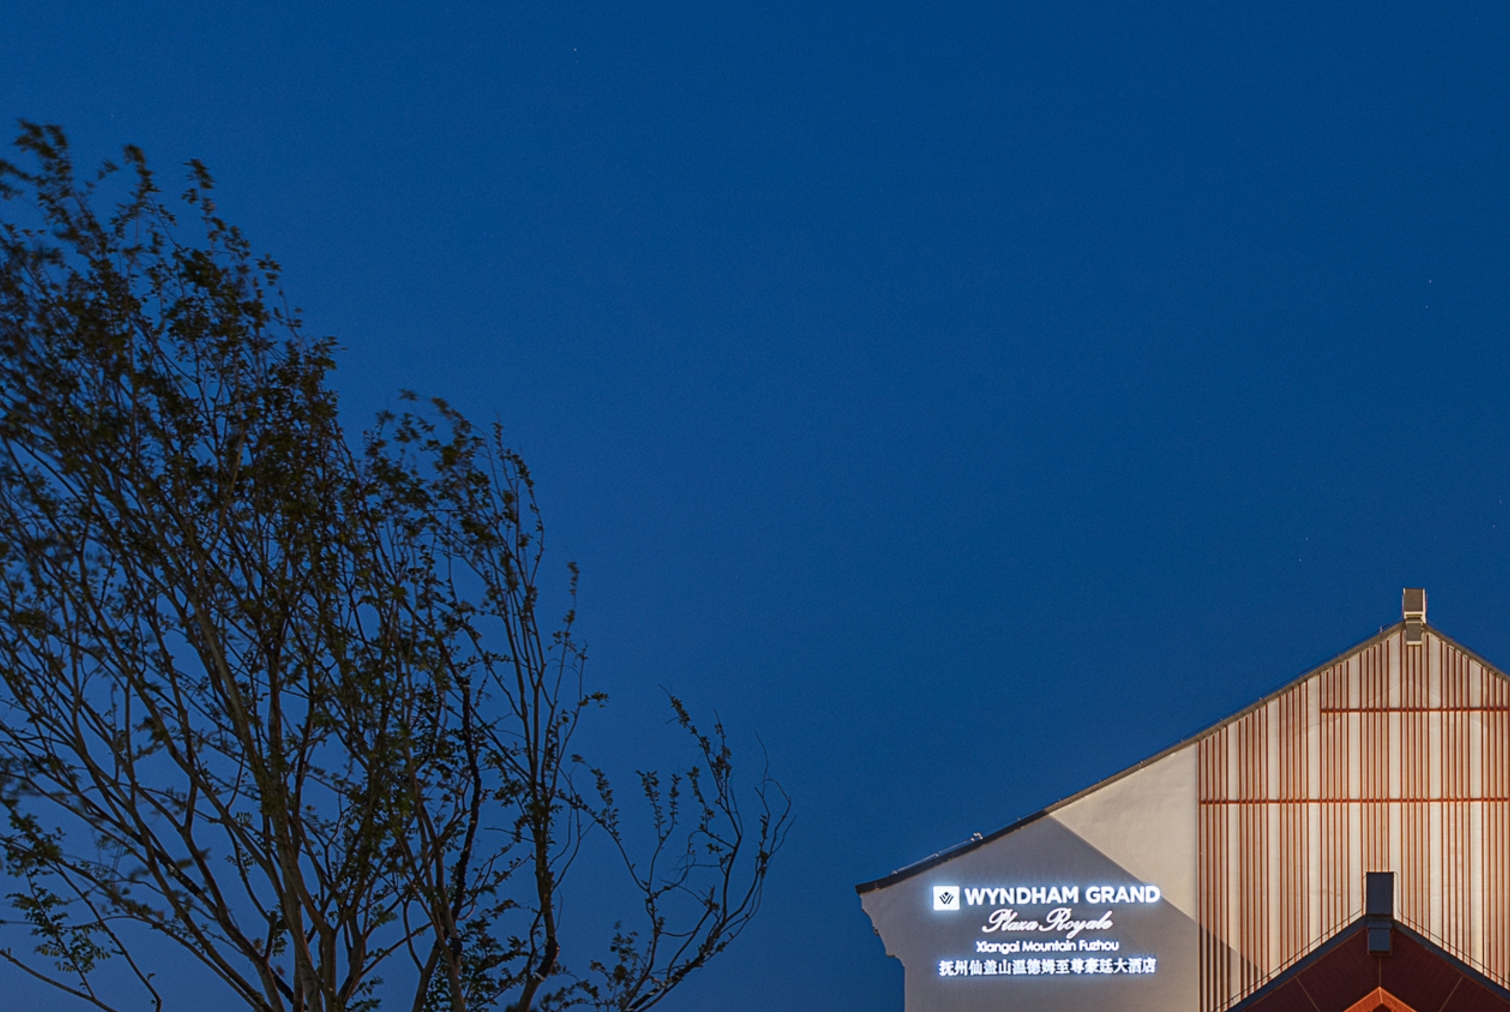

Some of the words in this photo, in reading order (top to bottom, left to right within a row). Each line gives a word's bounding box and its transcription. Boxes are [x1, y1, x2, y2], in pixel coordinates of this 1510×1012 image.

[964, 886, 1079, 906] WYNDHAM
[1085, 885, 1161, 904] GRAND
[982, 908, 1038, 933] Plaza
[1039, 908, 1113, 939] Royale
[976, 941, 1020, 955] Xiangai
[1022, 940, 1076, 953] Mountain
[1079, 940, 1119, 952] Fuzhou
